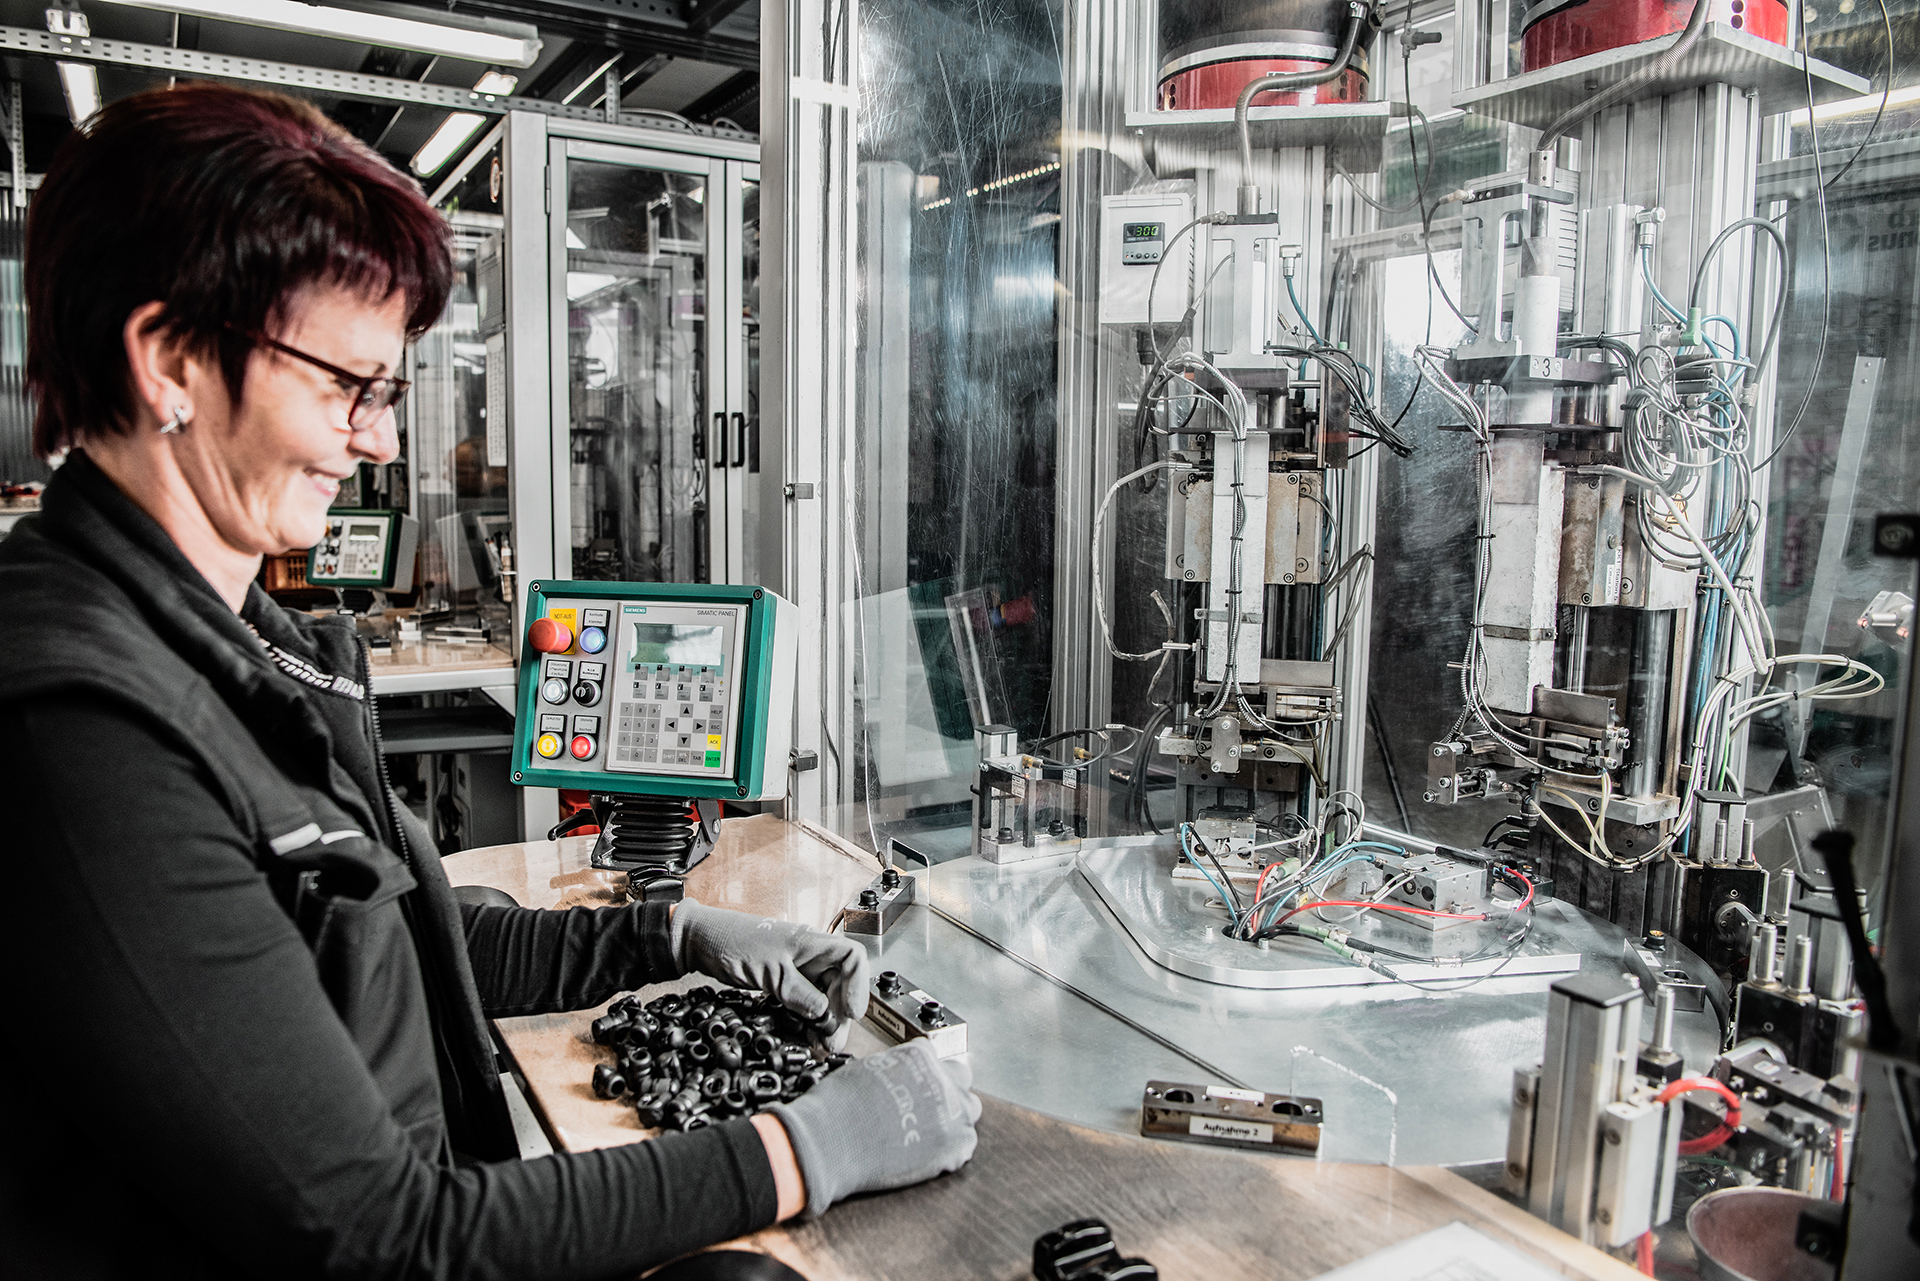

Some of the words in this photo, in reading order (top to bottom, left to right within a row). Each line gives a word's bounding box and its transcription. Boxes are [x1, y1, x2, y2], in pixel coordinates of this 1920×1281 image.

[1136, 226, 1158, 237] 300
[1542, 358, 1551, 377] 3
[901, 1112, 920, 1148] CE
[1203, 1123, 1250, 1135] Aufnahme
[1253, 1128, 1259, 1136] 2
